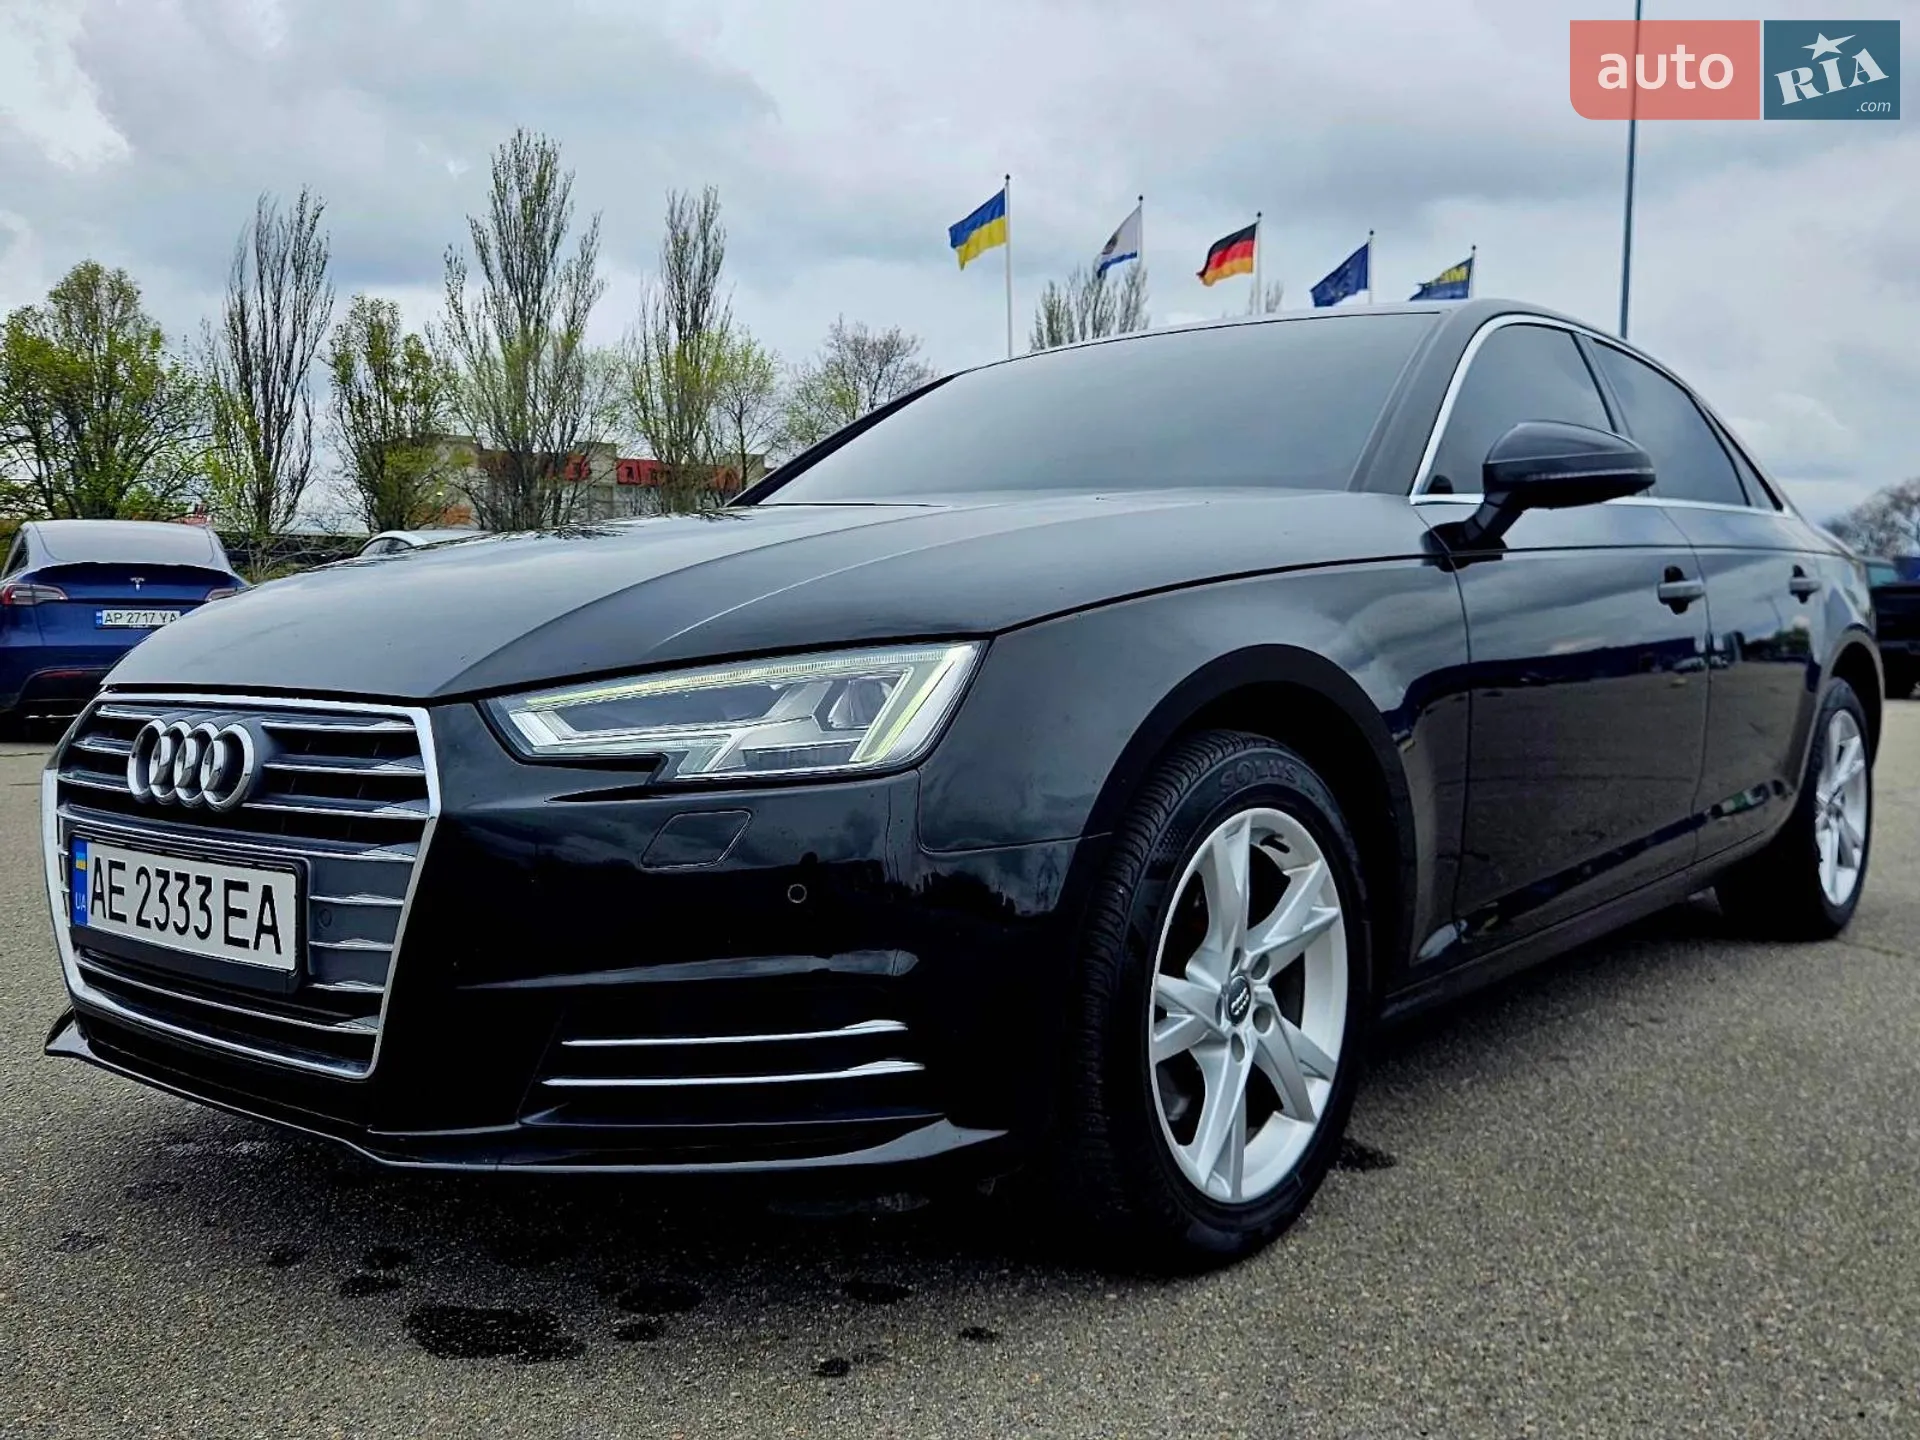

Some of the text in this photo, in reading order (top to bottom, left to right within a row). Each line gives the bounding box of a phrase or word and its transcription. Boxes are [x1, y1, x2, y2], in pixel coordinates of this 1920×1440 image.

[105, 612, 122, 624] AP
[126, 612, 155, 624] 2717
[90, 856, 282, 955] AE 2333 EA
